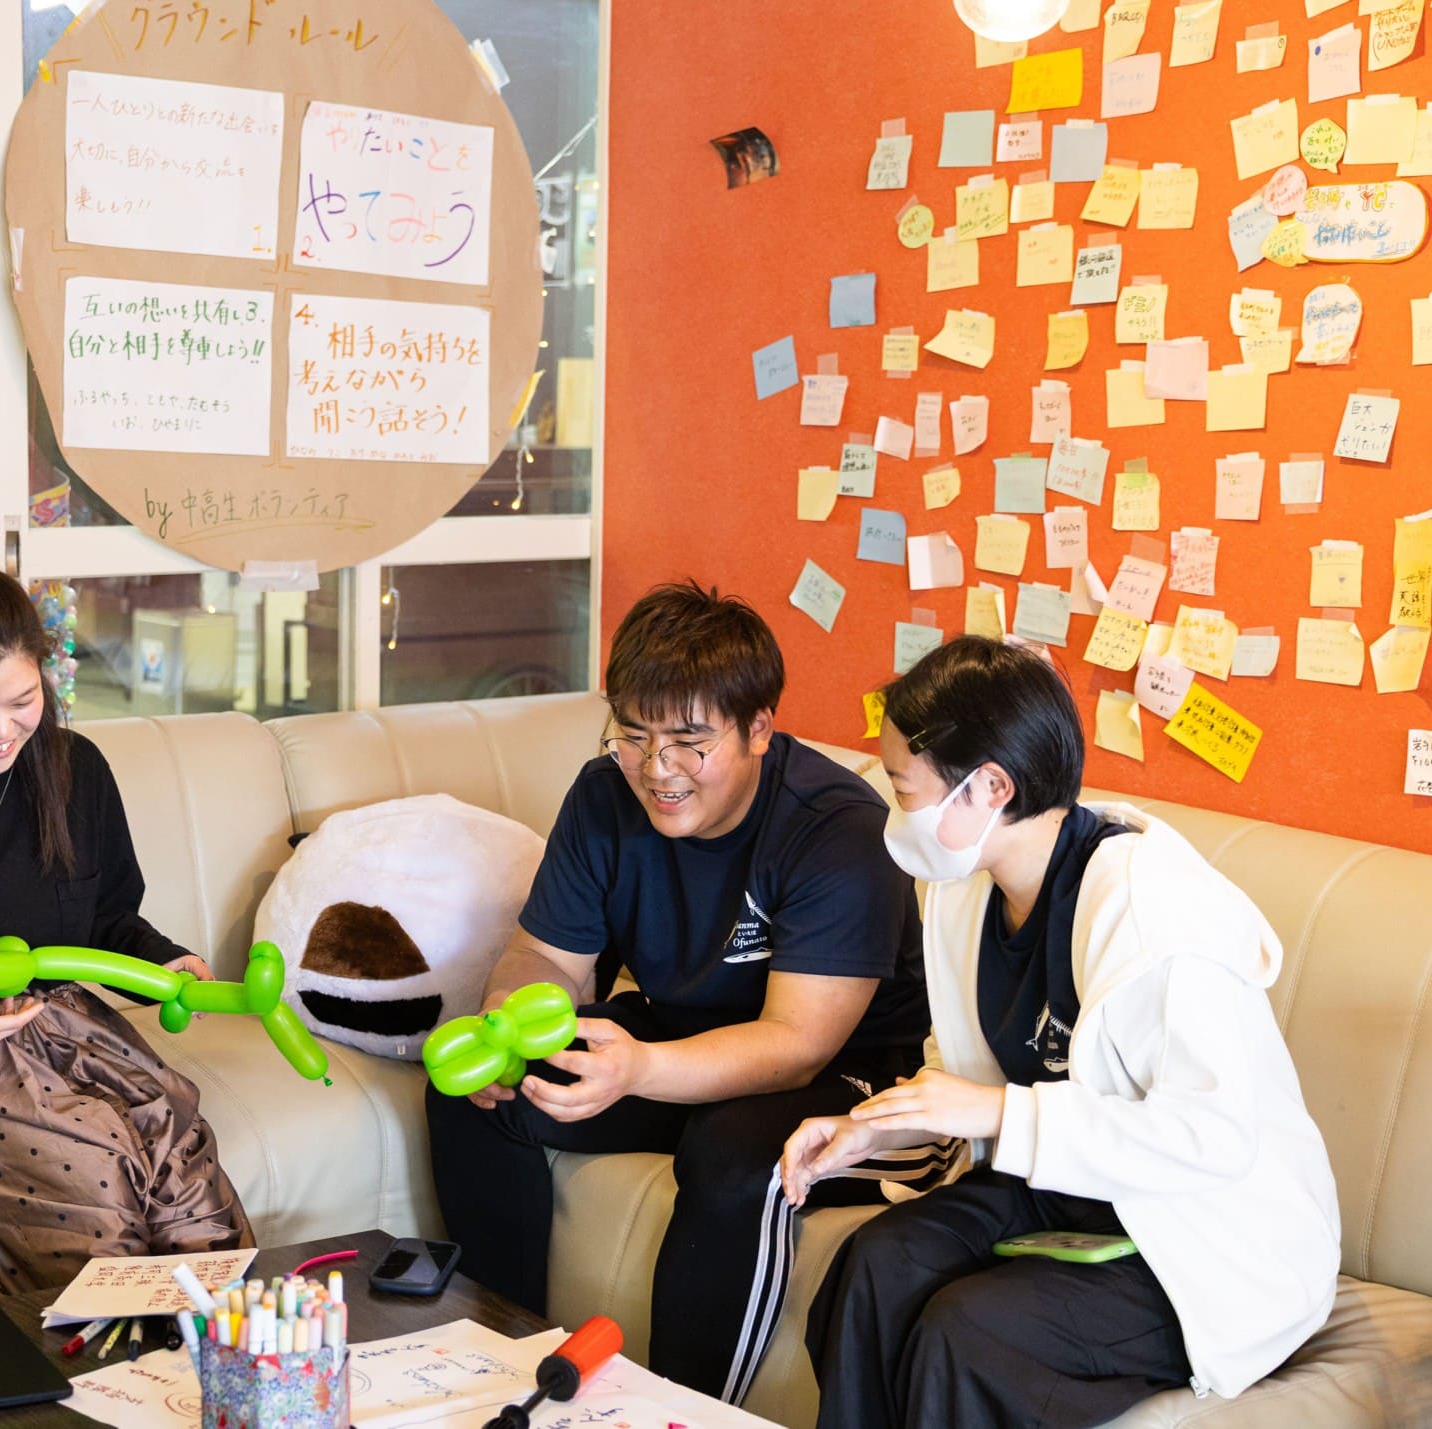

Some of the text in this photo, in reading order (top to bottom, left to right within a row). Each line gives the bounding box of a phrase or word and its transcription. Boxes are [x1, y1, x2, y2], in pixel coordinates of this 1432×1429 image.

[327, 322, 483, 366] 相手の気持ちを
[294, 359, 428, 396] 考えながら
[144, 488, 173, 538] by
